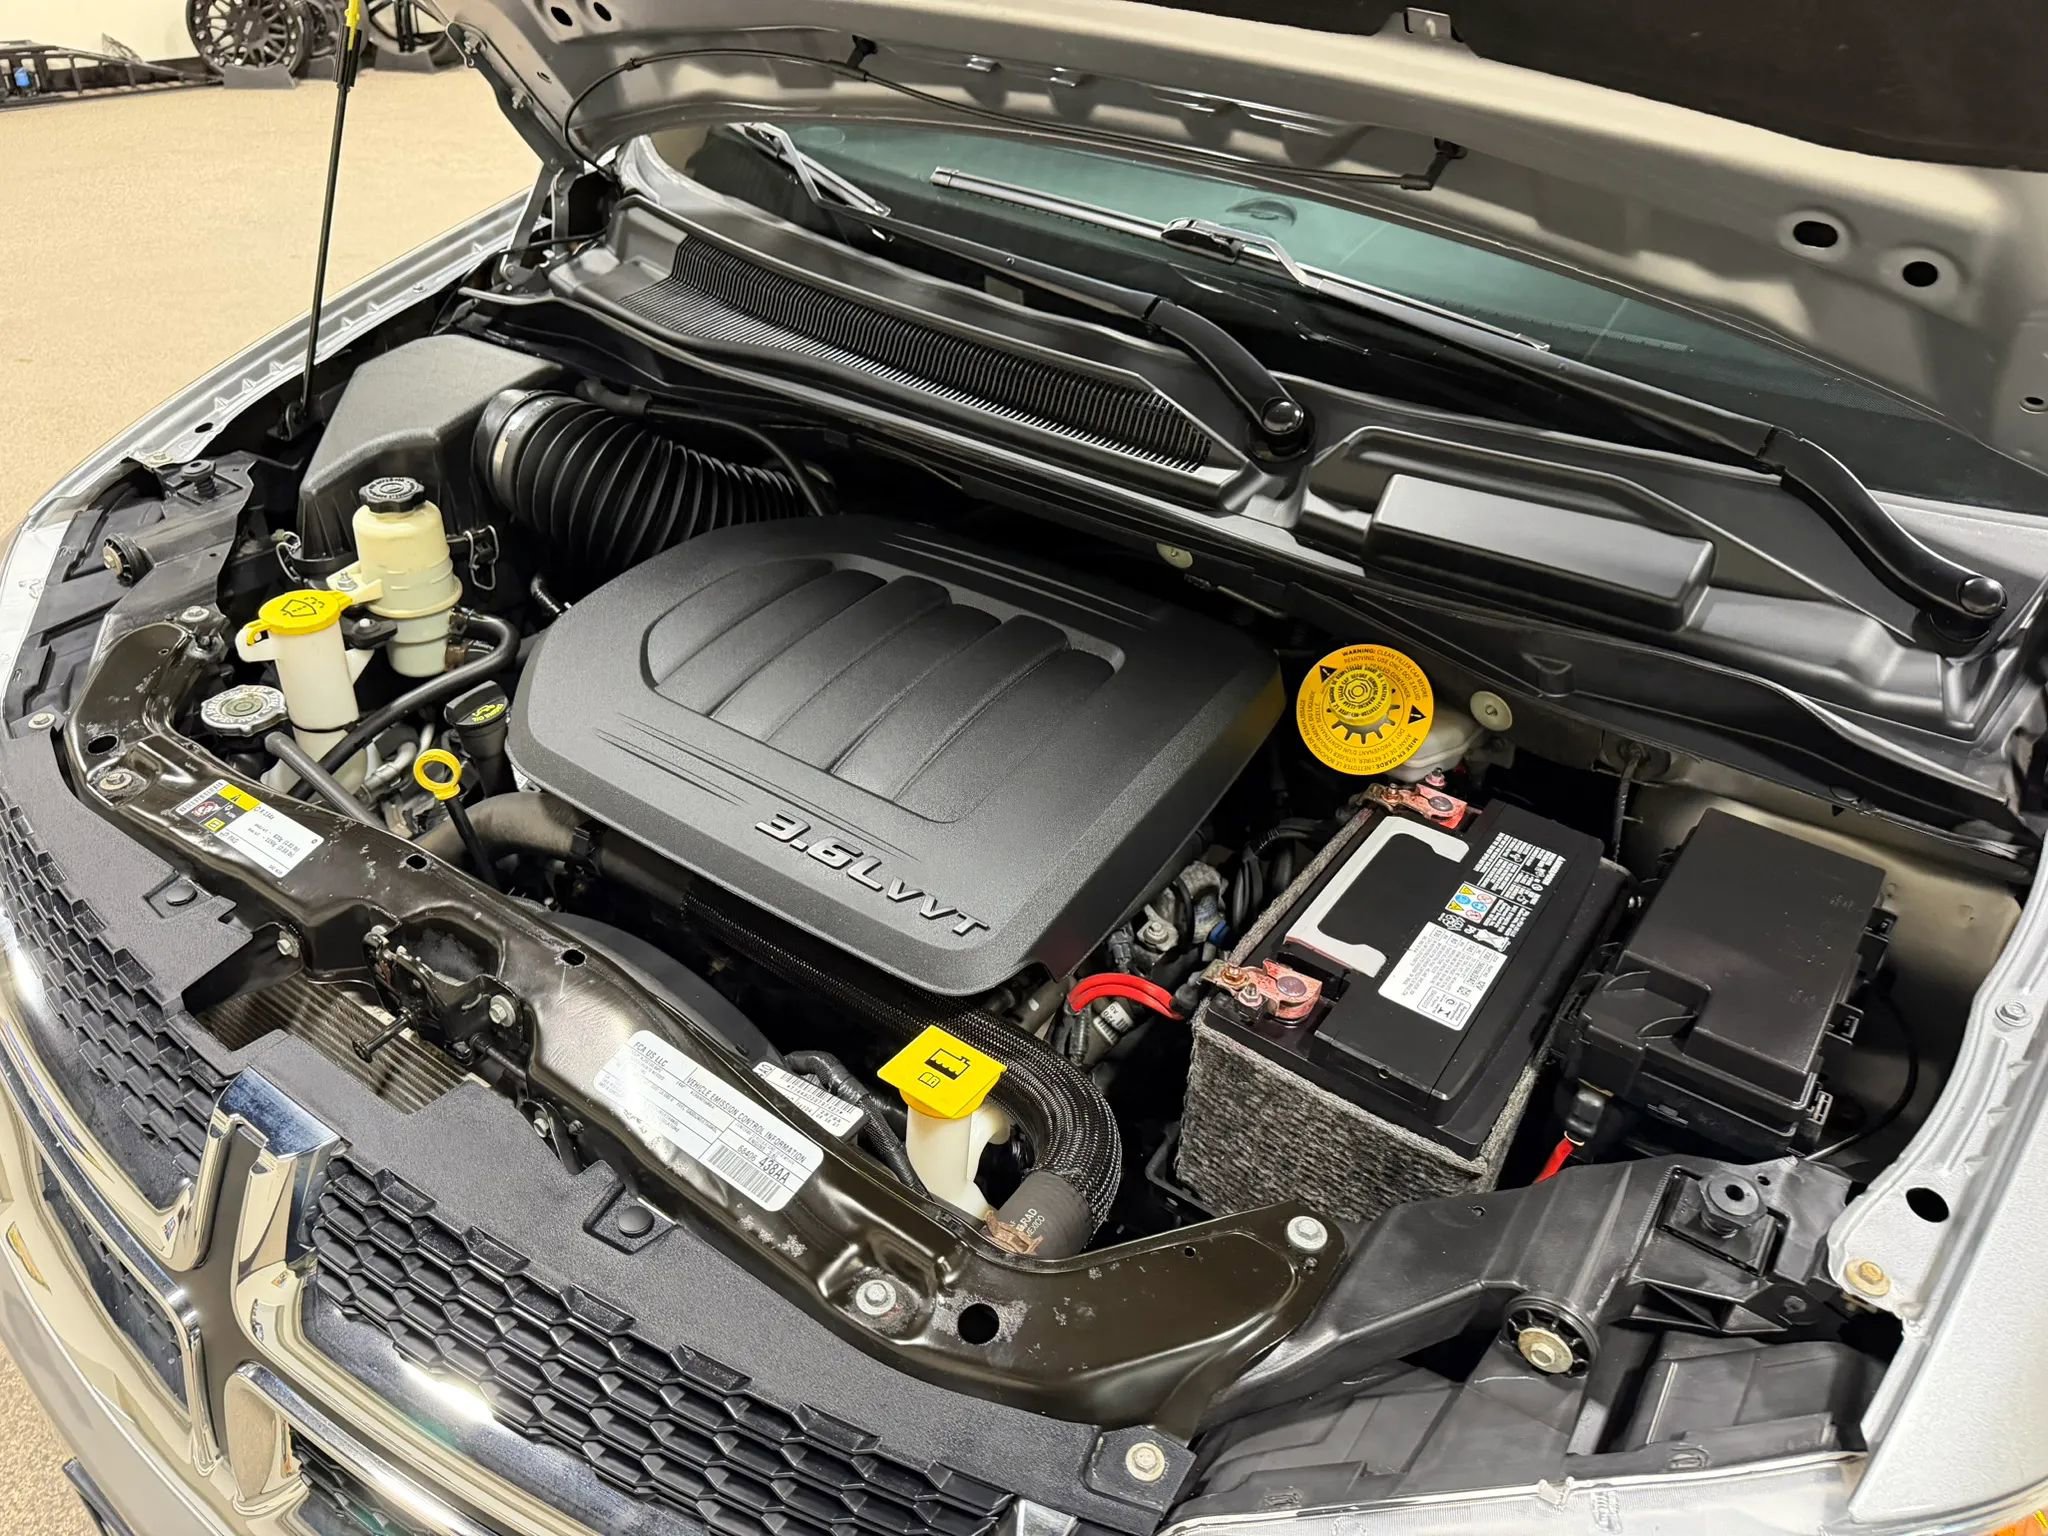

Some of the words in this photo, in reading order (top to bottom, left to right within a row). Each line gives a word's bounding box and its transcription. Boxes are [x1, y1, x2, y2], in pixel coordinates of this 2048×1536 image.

[1376, 650, 1395, 659] CLEAN
[1395, 656, 1411, 670] FILLER
[1409, 668, 1419, 678] CAP
[1416, 677, 1429, 698] BEFORE
[1389, 661, 1403, 672] ONLY
[1401, 670, 1412, 681] DOT
[1411, 685, 1421, 700] FLUID
[1307, 736, 1315, 744] DE
[1395, 729, 1405, 740] DOT
[1396, 733, 1412, 750] AVANT
[1405, 737, 1419, 751] MISE
[1312, 743, 1336, 764] BOUCHON
[1333, 751, 1356, 763] UTILISER
[1343, 763, 1371, 771] NETTOYER
[1376, 757, 1398, 769] GARDE
[756, 810, 884, 892] 3.6L
[886, 876, 992, 937] VVT
[633, 1041, 648, 1054] FCA
[645, 1049, 657, 1060] US
[654, 1055, 669, 1068] LLC
[686, 1076, 712, 1097] VEHICLE
[709, 1092, 740, 1117] EMISSION
[737, 1111, 766, 1135] CONTROL
[764, 1130, 807, 1164] INFORMATION
[756, 1155, 792, 1185] 438AA
